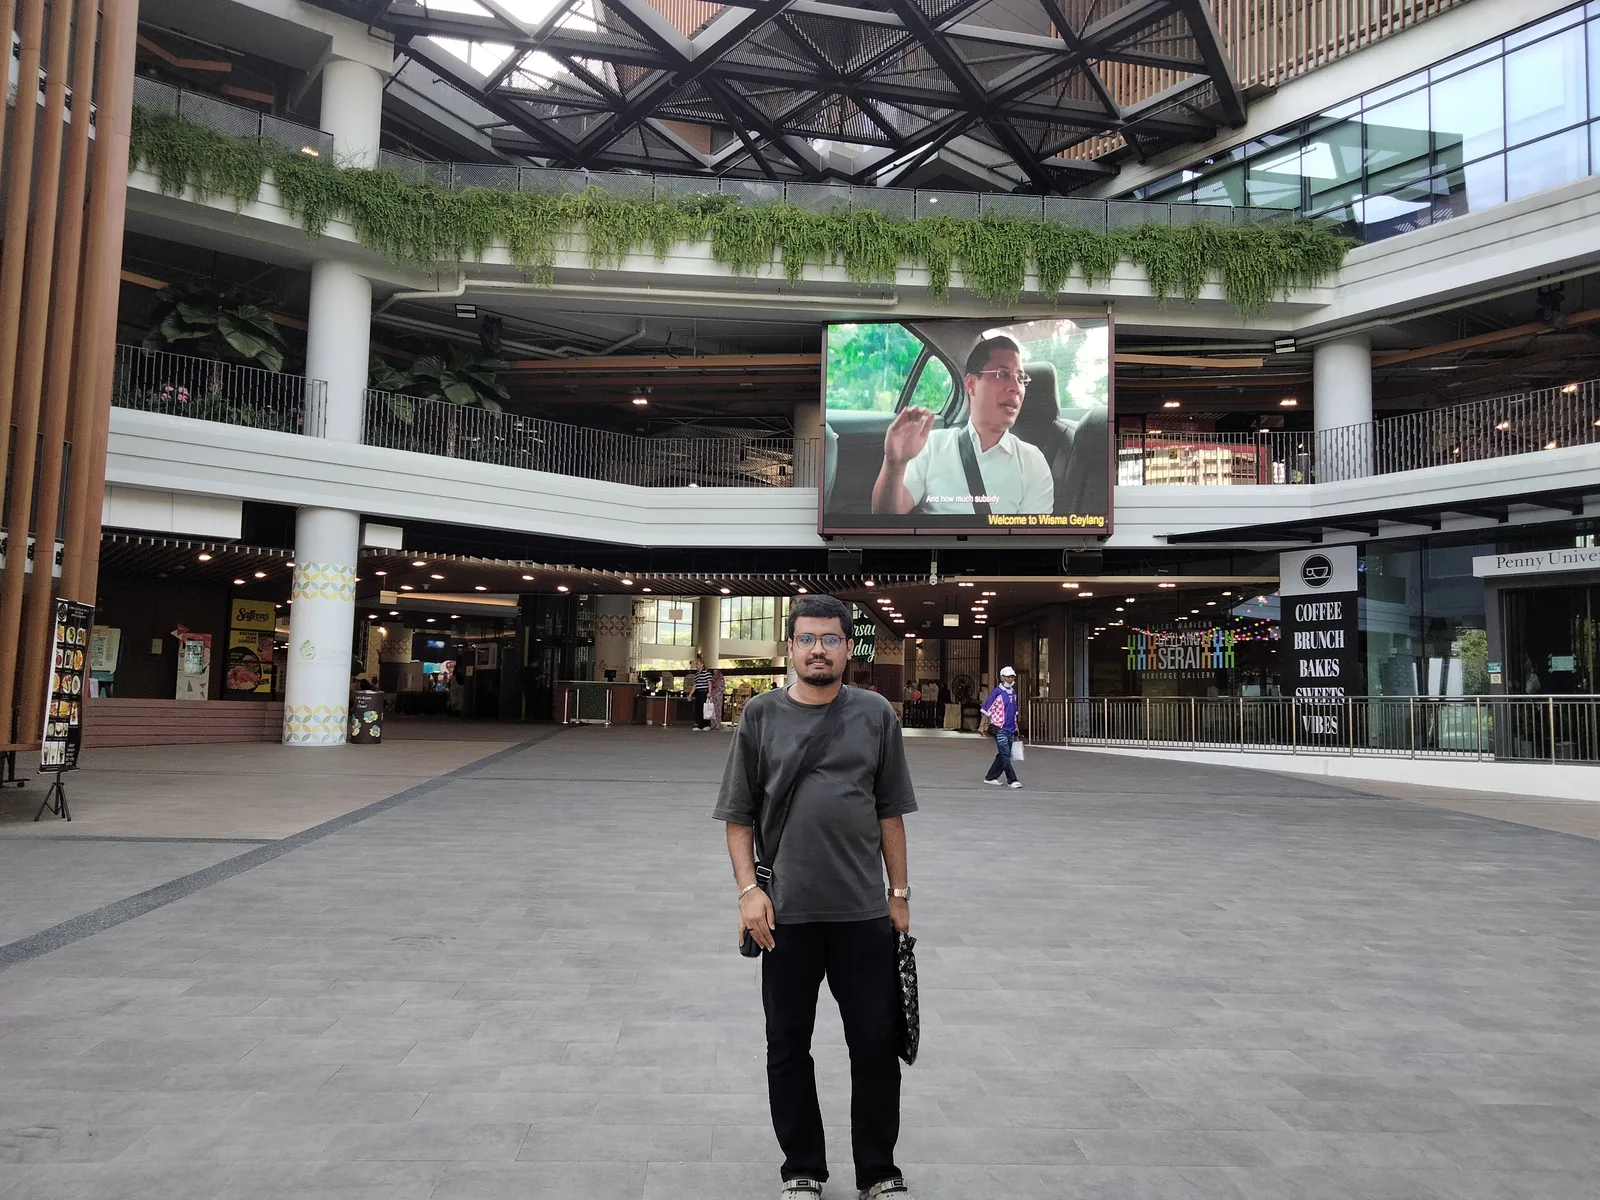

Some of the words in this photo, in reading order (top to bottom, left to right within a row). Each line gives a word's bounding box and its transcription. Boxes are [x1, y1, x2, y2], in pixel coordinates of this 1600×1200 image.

[926, 494, 940, 503] And
[940, 494, 954, 503] how
[955, 494, 973, 503] much
[974, 494, 1000, 504] subsidy
[988, 514, 1027, 526] Welcome
[1028, 515, 1037, 526] to
[1038, 514, 1068, 526] Wisma
[1069, 514, 1105, 528] Geylang
[1496, 556, 1544, 570] Penny
[1548, 550, 1600, 565] Unive
[236, 607, 270, 622] Saffrons
[1295, 602, 1343, 622] COFFEE
[1294, 630, 1345, 650] BRUNCH
[1158, 646, 1200, 670] SERAI
[1141, 672, 1177, 680] HERITAGE
[1181, 671, 1216, 679] GALLERY
[1299, 659, 1340, 677] BAKES
[1295, 687, 1345, 706] SWEETS
[1302, 715, 1338, 735] VIBES
